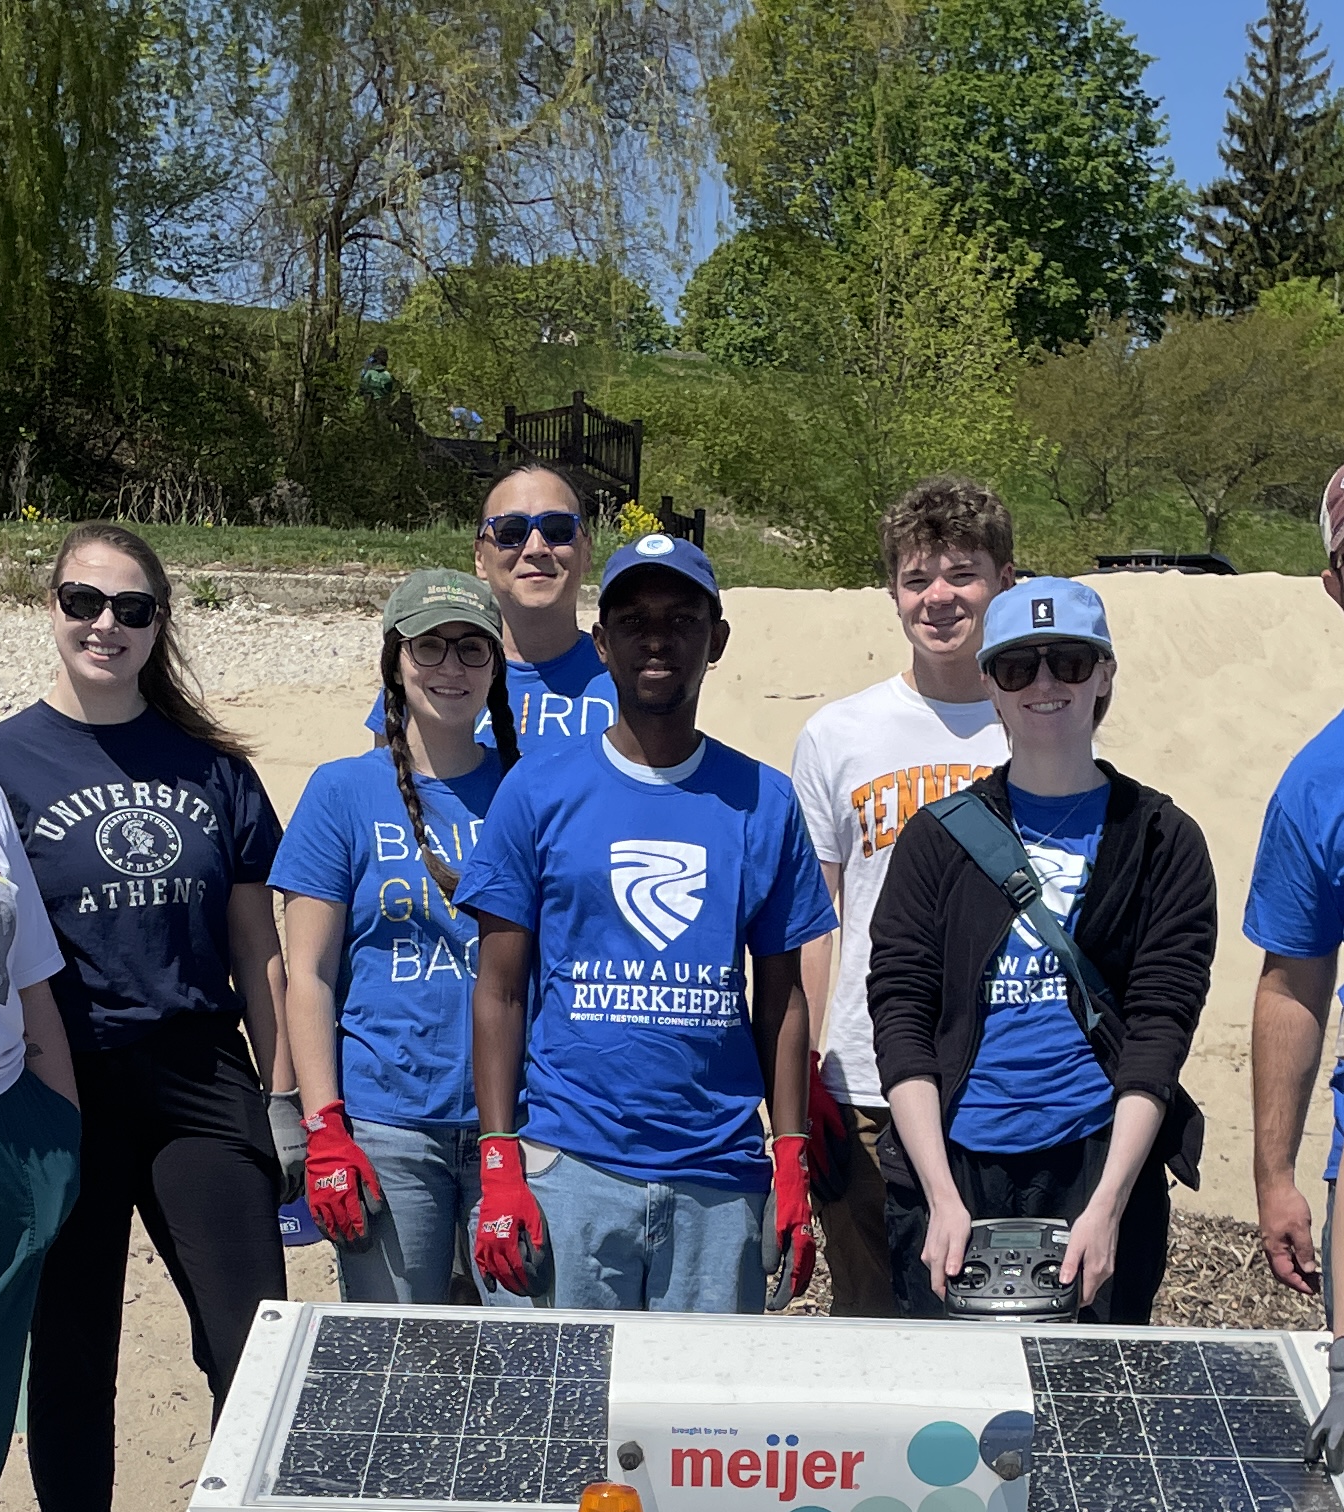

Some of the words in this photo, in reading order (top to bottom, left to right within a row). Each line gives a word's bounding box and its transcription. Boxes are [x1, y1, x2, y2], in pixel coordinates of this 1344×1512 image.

[34, 782, 219, 841] UNIVERSITY
[78, 877, 207, 914] ATHENS
[570, 1013, 604, 1022] PROTECT
[610, 1014, 650, 1024] RESTORE
[657, 1016, 700, 1027] CONNECT
[671, 1433, 865, 1502] meijer
